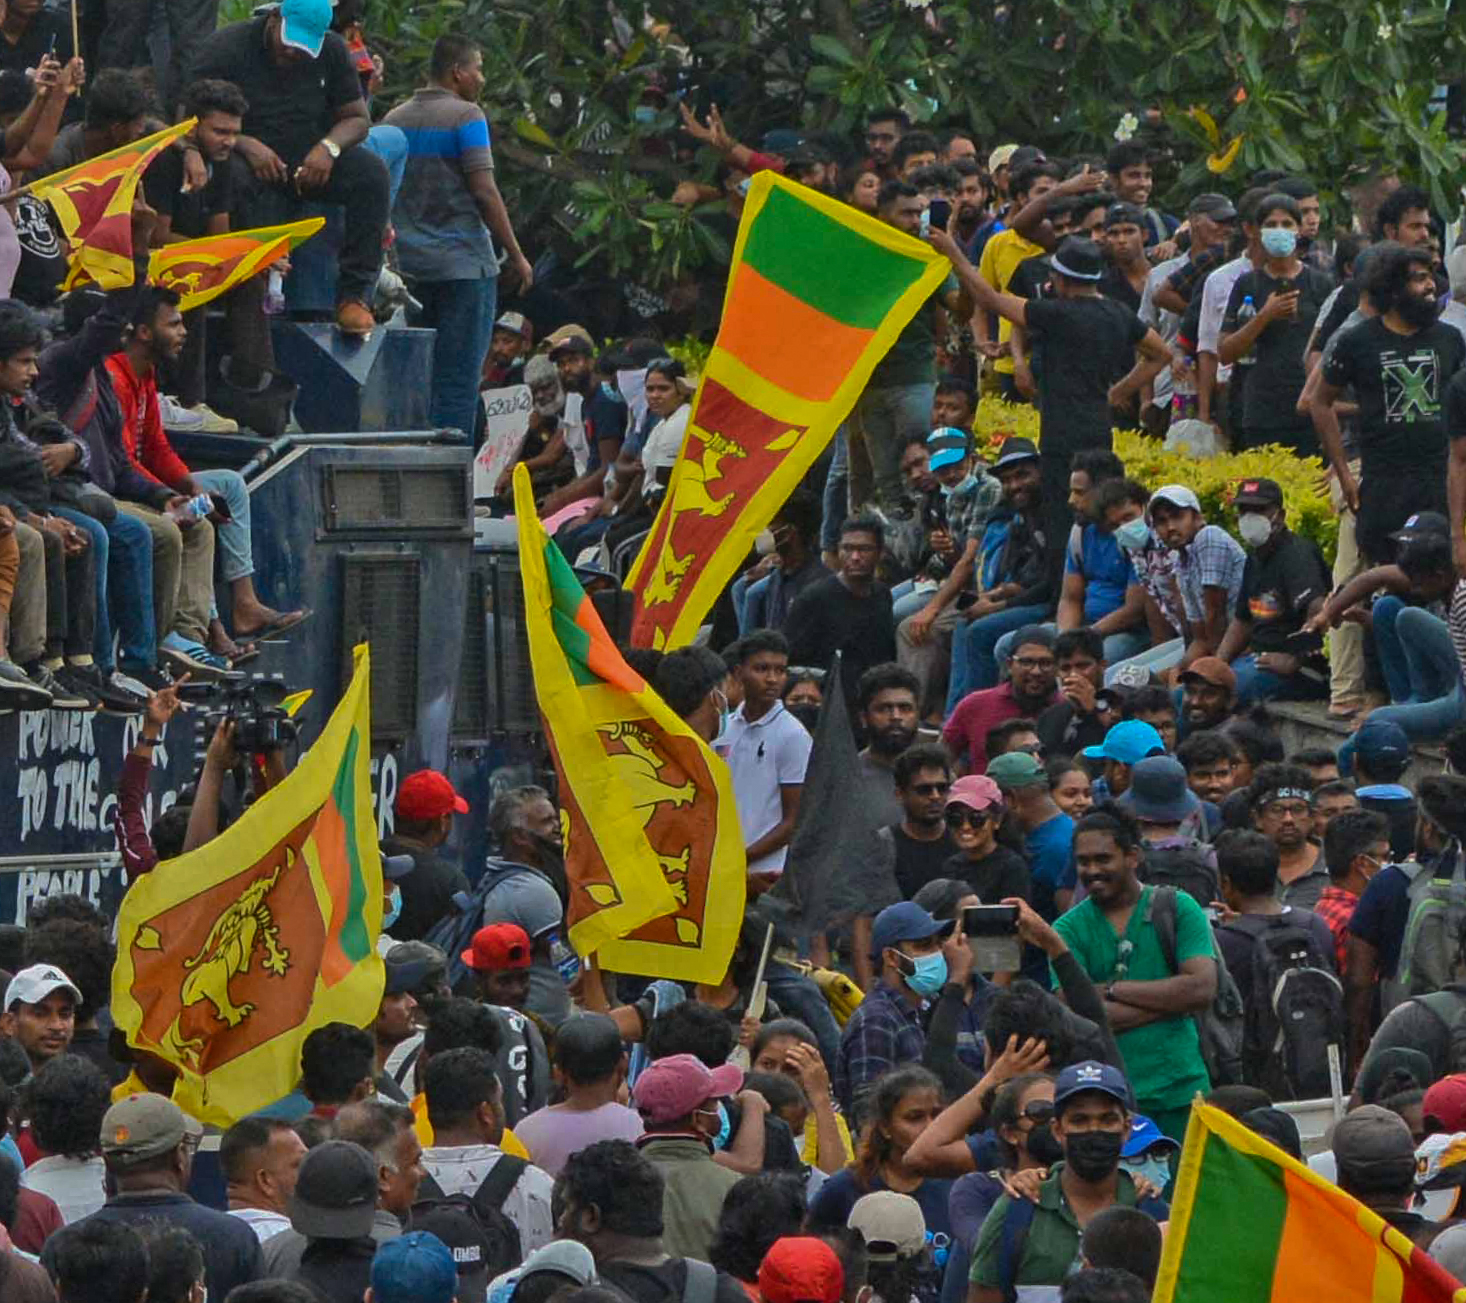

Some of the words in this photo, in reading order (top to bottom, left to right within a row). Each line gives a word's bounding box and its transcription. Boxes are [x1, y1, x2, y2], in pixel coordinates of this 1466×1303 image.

[18, 708, 98, 761] POWER
[17, 766, 48, 842] TO
[53, 757, 100, 832] THE
